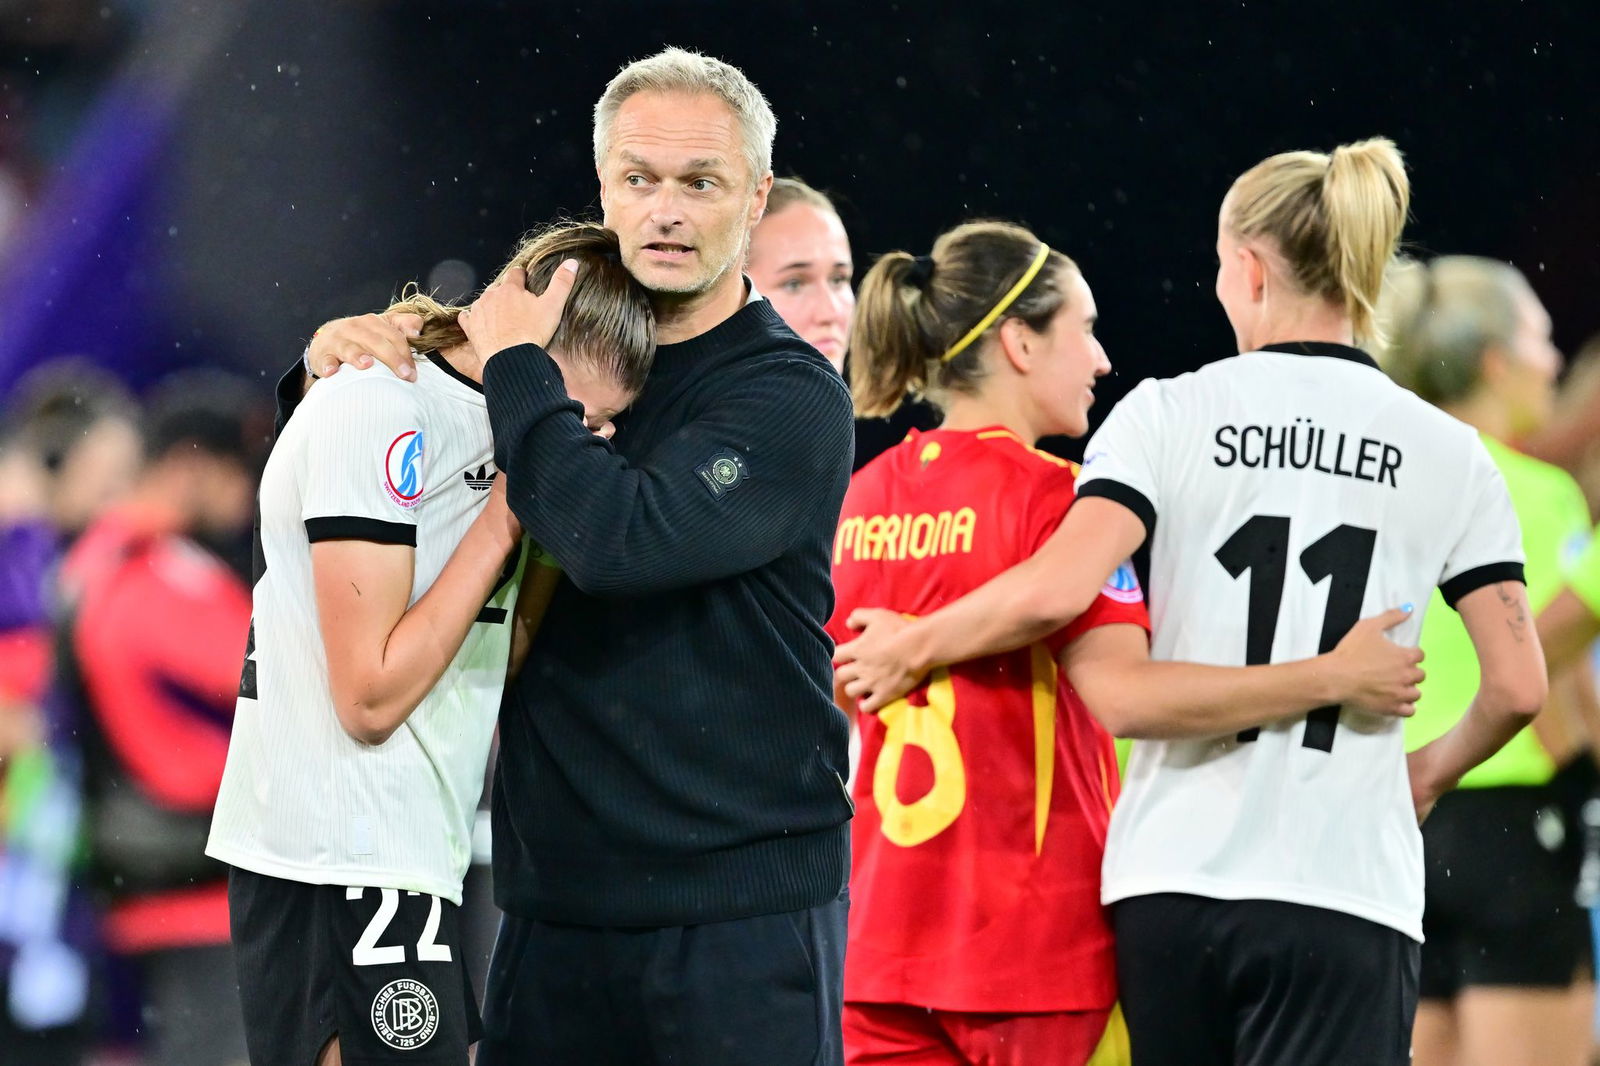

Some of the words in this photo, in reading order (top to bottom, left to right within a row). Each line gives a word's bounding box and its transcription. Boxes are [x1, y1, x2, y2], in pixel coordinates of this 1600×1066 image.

[1213, 417, 1402, 488] SCHÜLLER
[834, 506, 976, 566] MARIONA
[1214, 514, 1378, 754] 11
[873, 613, 966, 847] 8
[345, 886, 453, 966] 22
[375, 986, 395, 1041] DEUTSCHER
